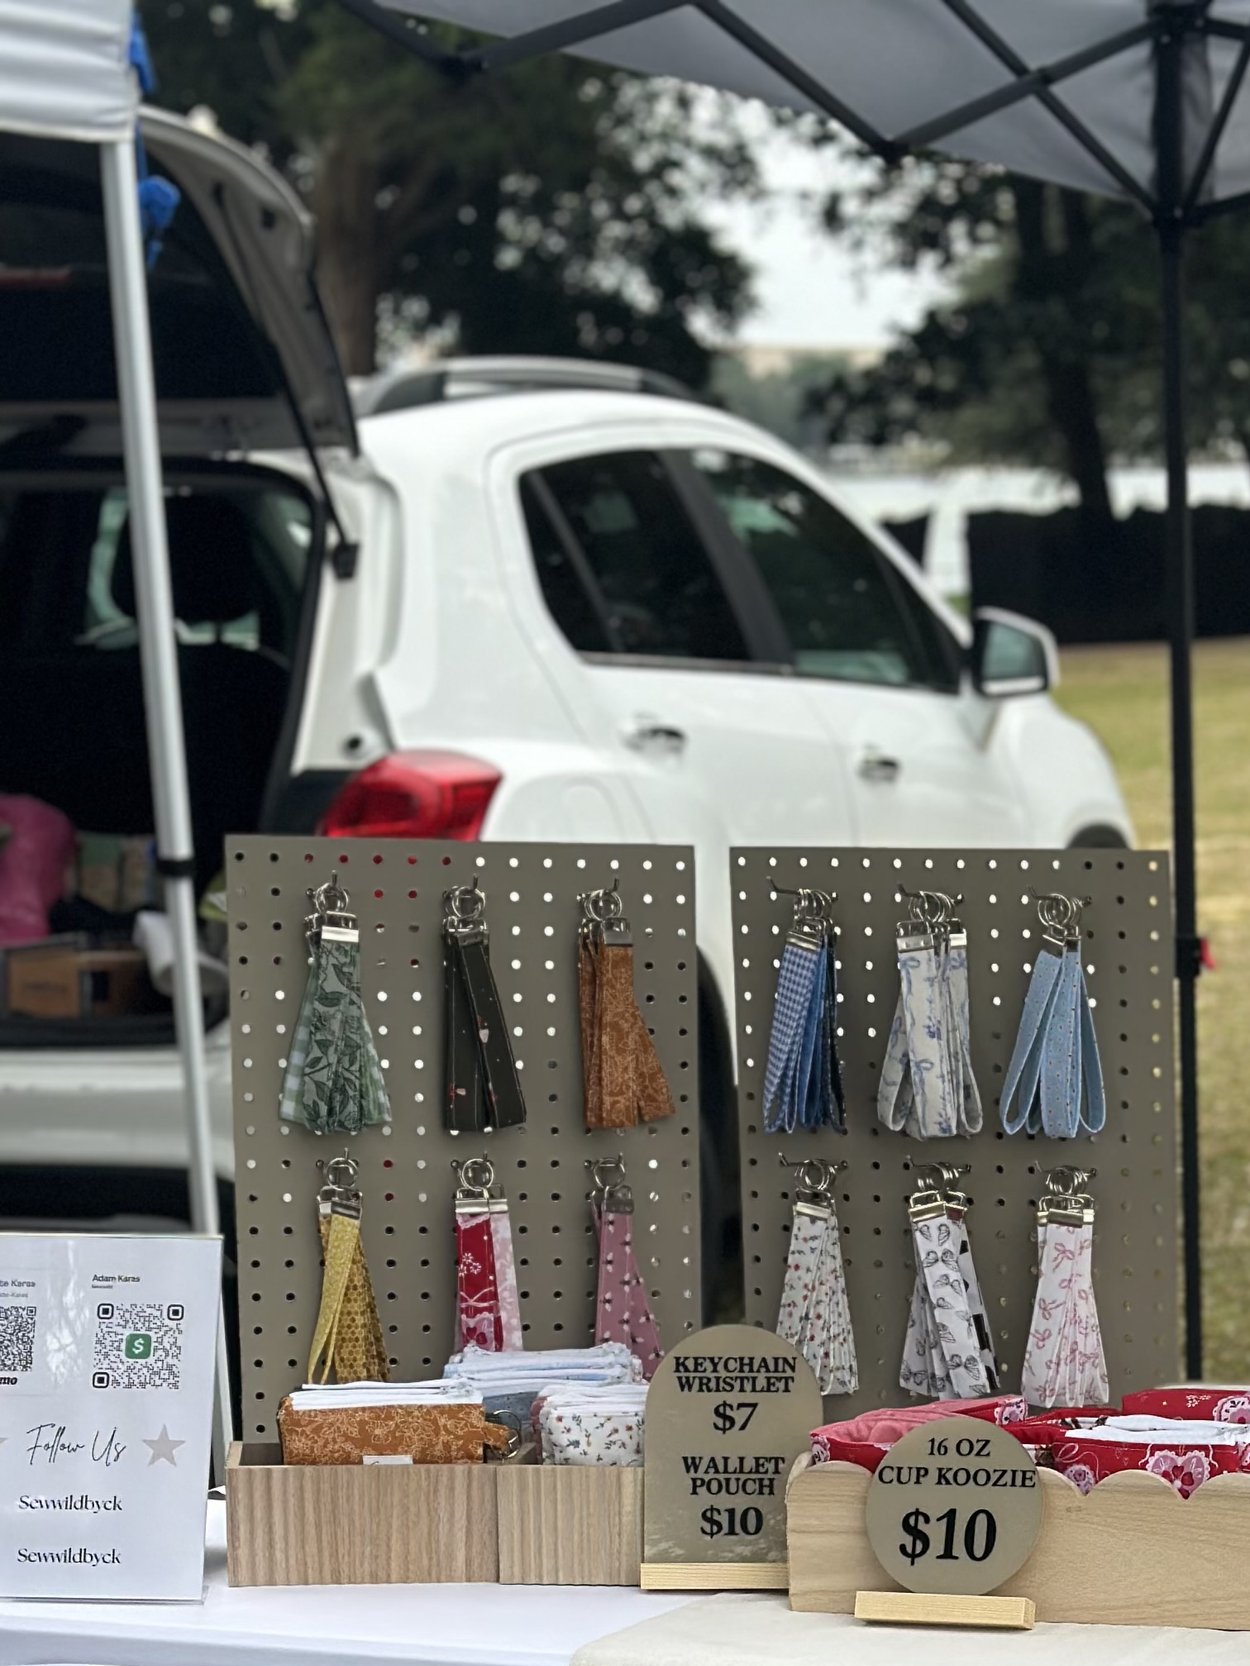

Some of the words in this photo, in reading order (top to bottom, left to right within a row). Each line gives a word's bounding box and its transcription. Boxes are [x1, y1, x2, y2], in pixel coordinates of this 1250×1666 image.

[92, 1274, 117, 1283] Adam
[673, 1356, 797, 1374] KEYCHAIN
[676, 1376, 795, 1393] WRISTLET
[713, 1400, 759, 1434] $7
[26, 1423, 85, 1466] Follow
[91, 1426, 127, 1467] Us
[927, 1437, 949, 1456] 16
[955, 1438, 991, 1457] OZ
[681, 1456, 785, 1474] WALLET
[690, 1477, 775, 1495] POUCH
[878, 1465, 929, 1485] CUP
[935, 1467, 1036, 1488] KOOZIE
[18, 1494, 123, 1514] Sewwildbyck
[700, 1504, 764, 1539] $10
[898, 1508, 997, 1566] $10
[17, 1547, 121, 1567] Sewwildbyck
